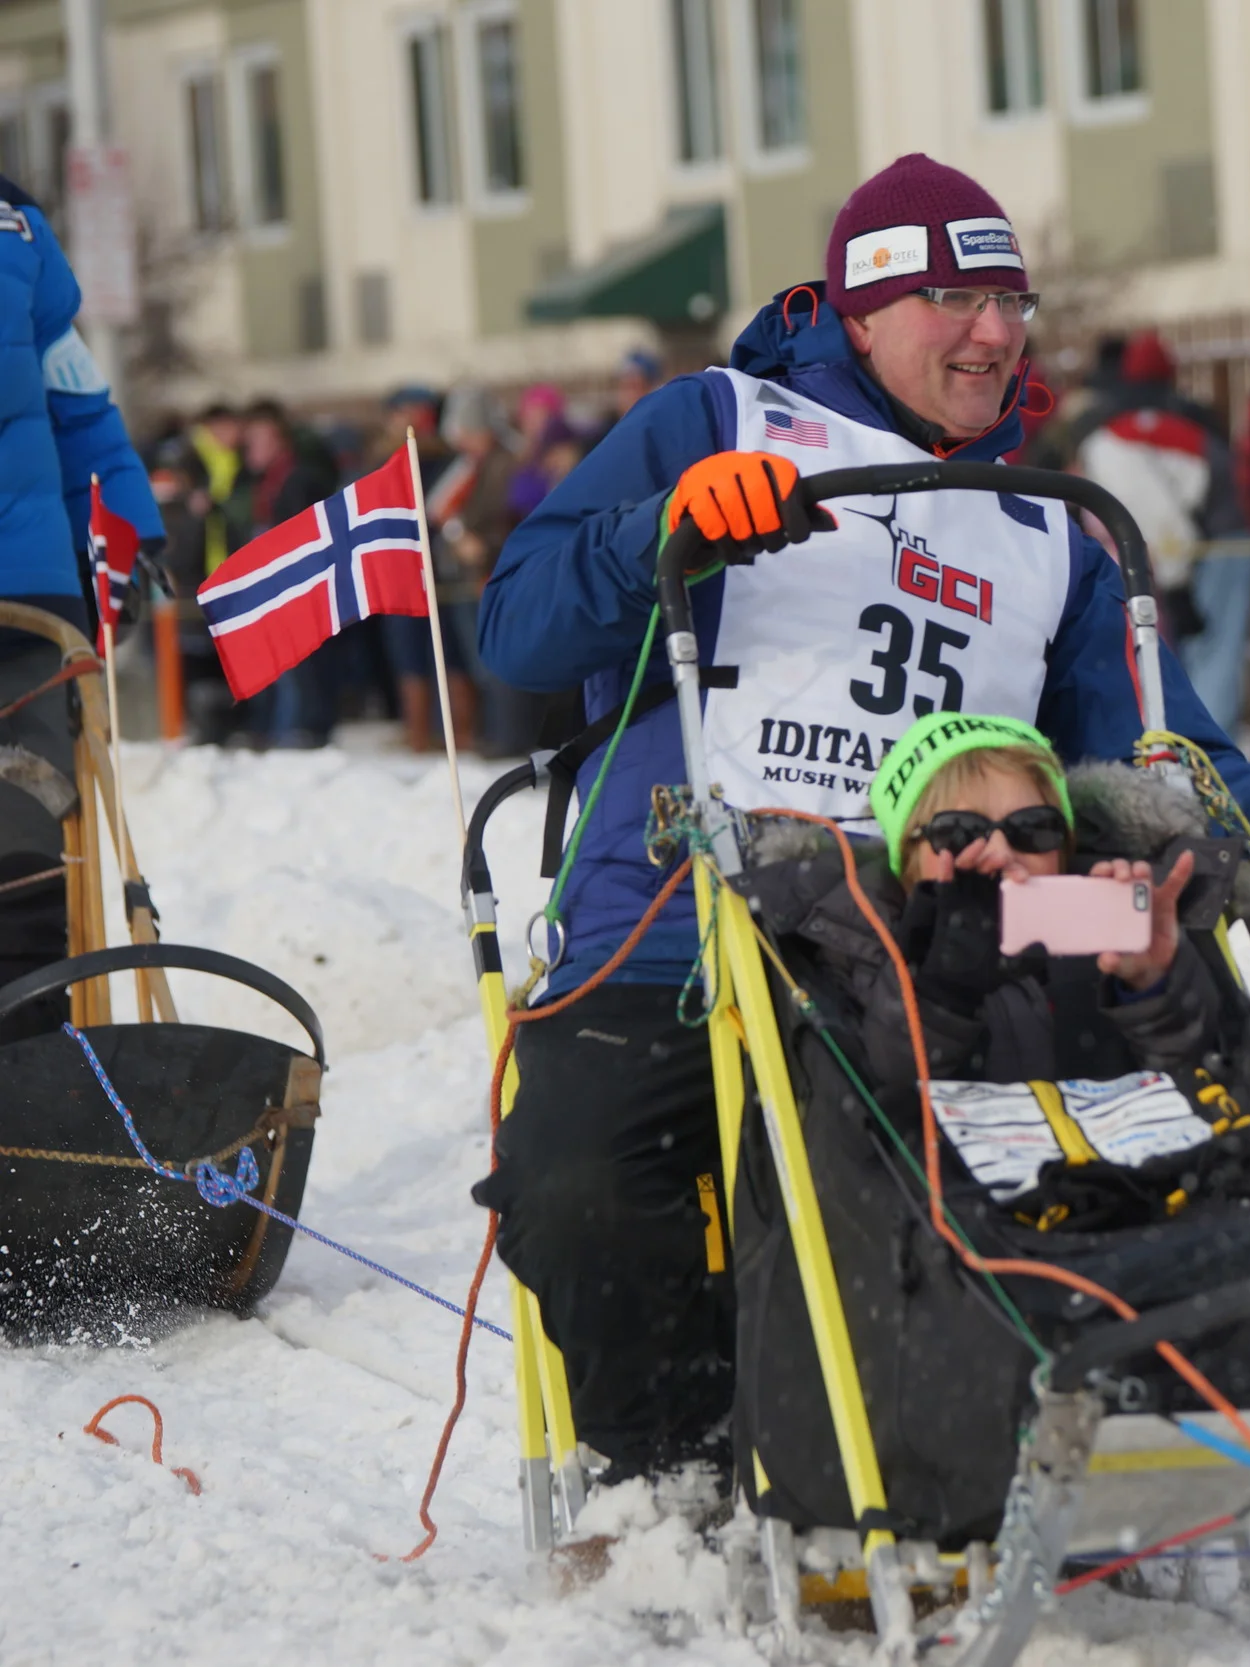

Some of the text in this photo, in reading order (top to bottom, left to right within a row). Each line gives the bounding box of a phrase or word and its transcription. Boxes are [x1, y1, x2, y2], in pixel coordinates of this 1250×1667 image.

[897, 547, 993, 625] GCI
[850, 603, 970, 719] 35
[763, 767, 872, 796] MUSH W
